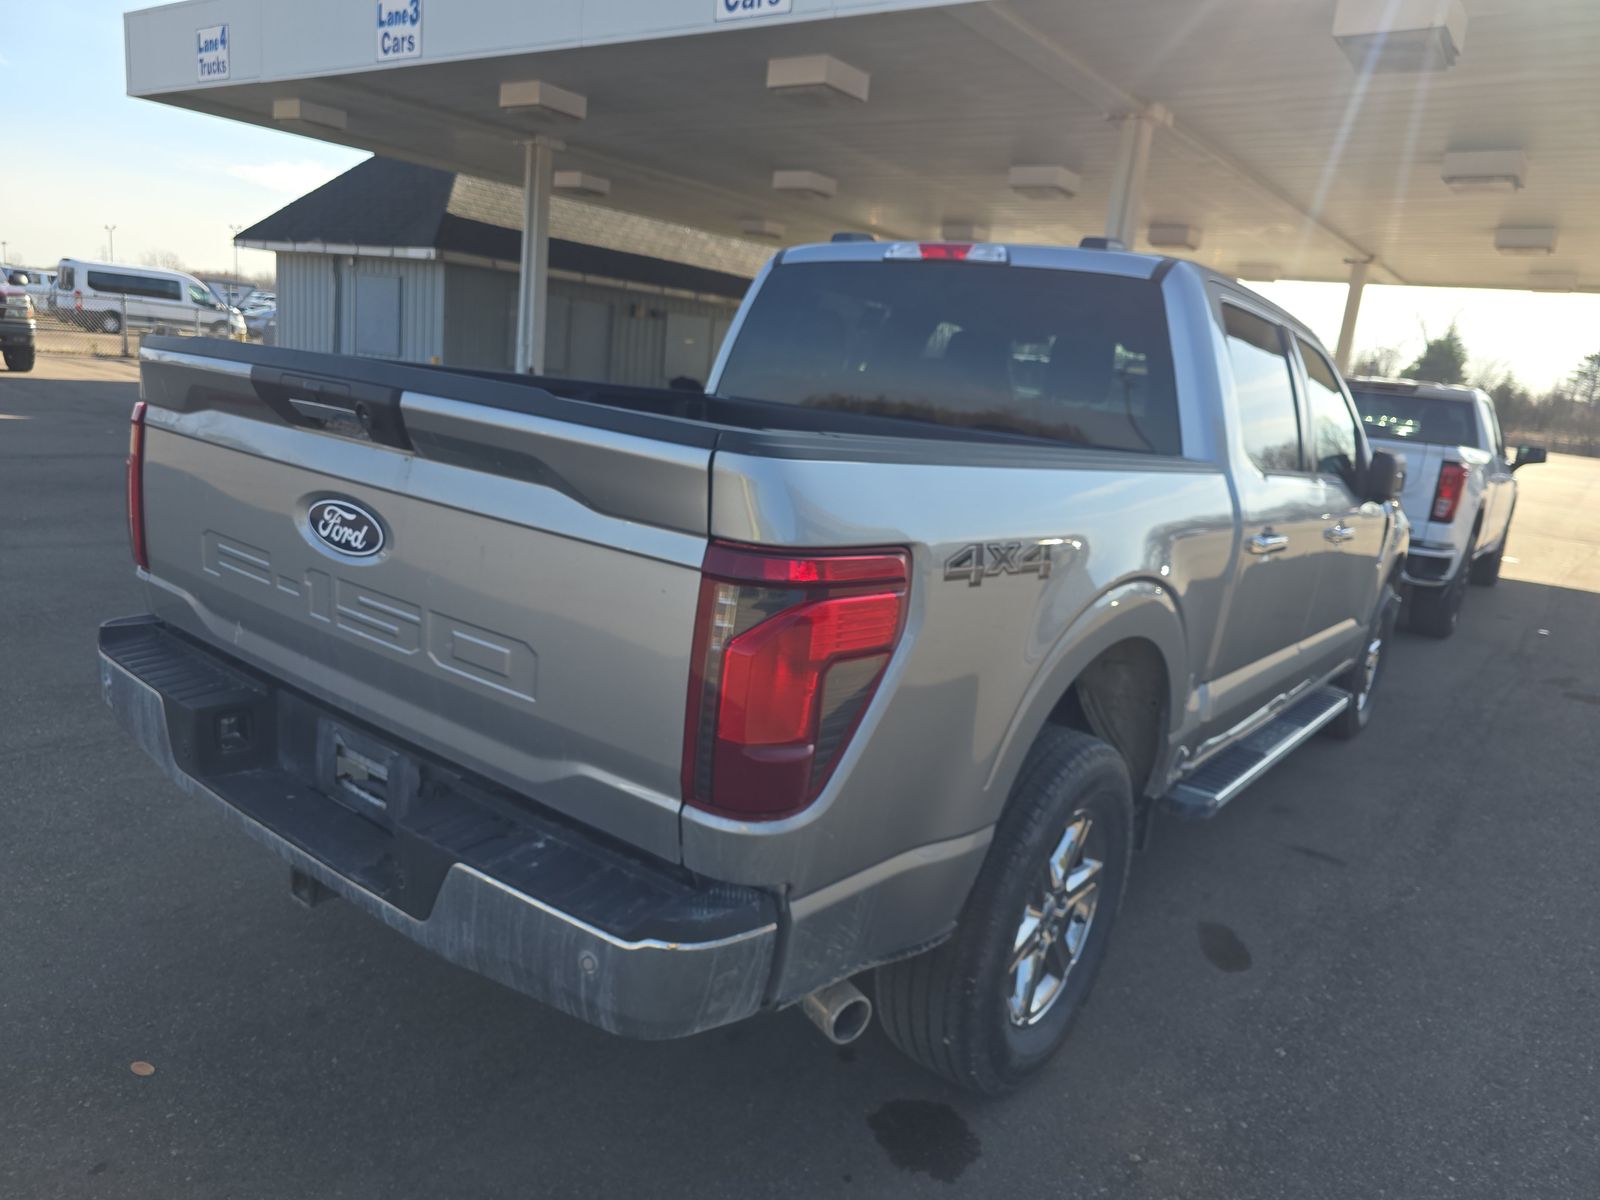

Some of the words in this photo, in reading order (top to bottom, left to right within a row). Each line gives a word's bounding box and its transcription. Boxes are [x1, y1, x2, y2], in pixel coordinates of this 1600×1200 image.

[381, 31, 416, 55] Cars
[199, 56, 227, 76] Trucks
[318, 505, 369, 549] Ford
[202, 529, 538, 702] F-150
